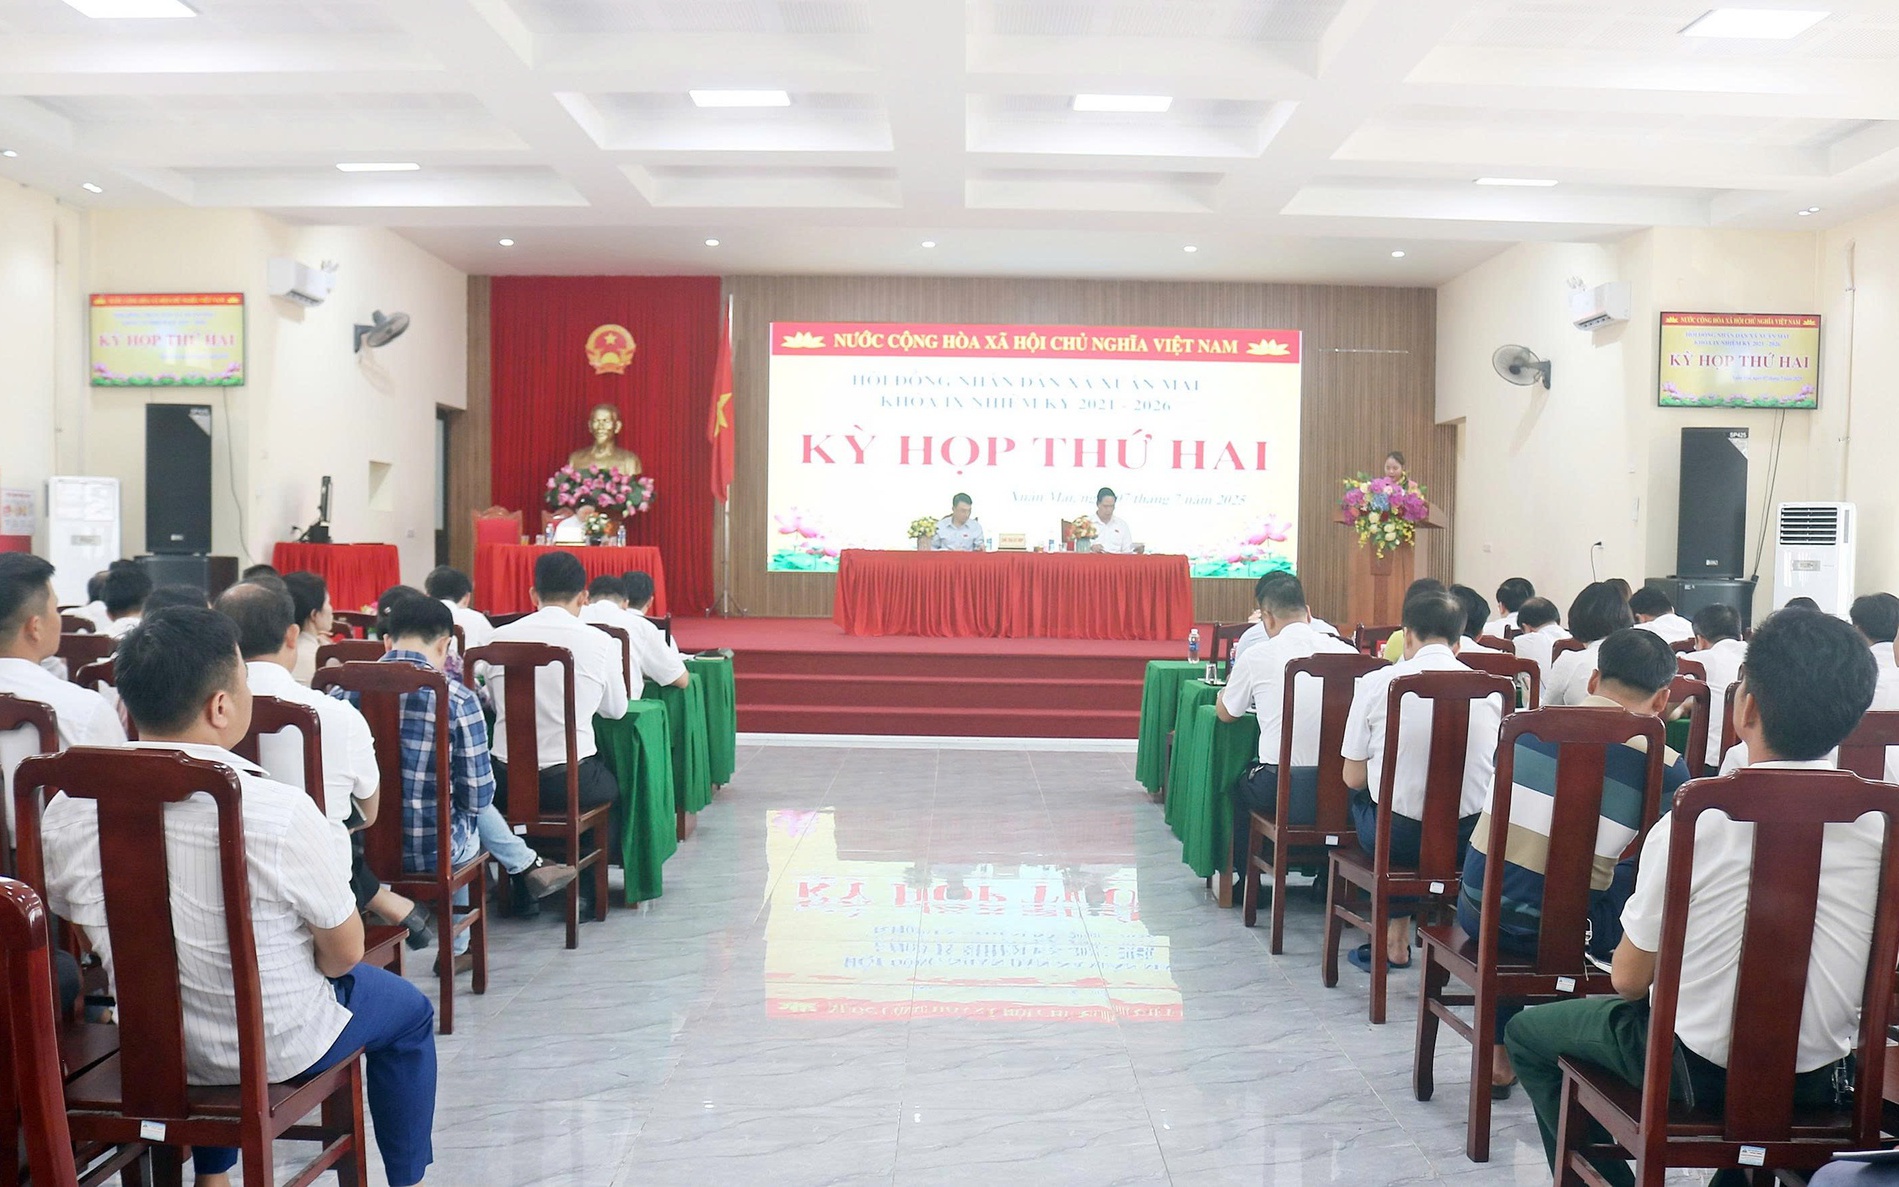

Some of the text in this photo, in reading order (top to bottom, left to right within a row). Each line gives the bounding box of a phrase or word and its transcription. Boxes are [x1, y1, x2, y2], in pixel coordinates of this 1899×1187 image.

[833, 330, 1239, 356] NƯỚC CỘNG HÒA XÃ HỘI CHỦ NGHĨA VIỆT NAM
[1780, 357, 1809, 369] HAI
[802, 424, 1267, 475] KỲ HỌP THỨ HAI
